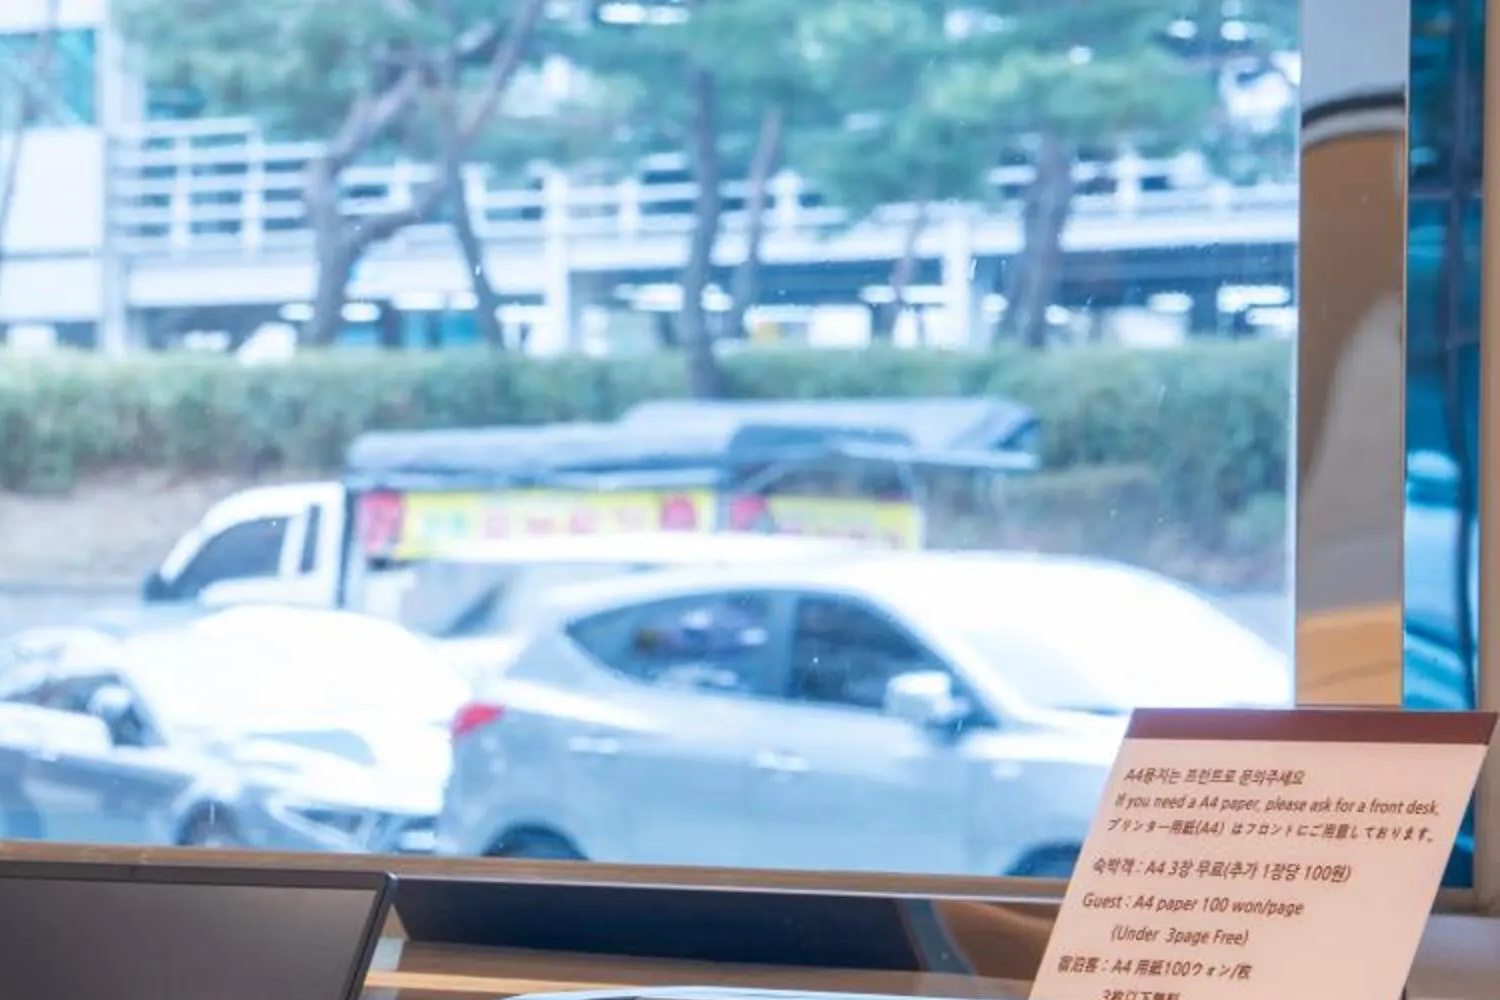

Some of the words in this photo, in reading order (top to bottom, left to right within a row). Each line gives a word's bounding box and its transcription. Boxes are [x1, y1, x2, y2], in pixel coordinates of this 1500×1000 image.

[1126, 795, 1150, 810] you
[1154, 795, 1185, 809] need
[1188, 799, 1197, 809] a
[1199, 796, 1218, 808] A4
[1265, 795, 1306, 813] please
[1310, 796, 1332, 812] ask
[1334, 798, 1354, 814] for
[1358, 802, 1367, 813] a
[1369, 798, 1404, 814] front
[1145, 859, 1166, 875] A4
[1168, 861, 1195, 879] 3장
[1304, 865, 1352, 883] 100원)
[1083, 893, 1123, 909] Guest
[1133, 894, 1155, 909] A4
[1156, 898, 1198, 915] paper
[1202, 896, 1228, 912] 100
[1231, 898, 1304, 917] won/page
[1111, 927, 1158, 944] (Under
[1166, 929, 1209, 946] 3page
[1213, 930, 1248, 947] Free)
[1111, 960, 1132, 974] A4
